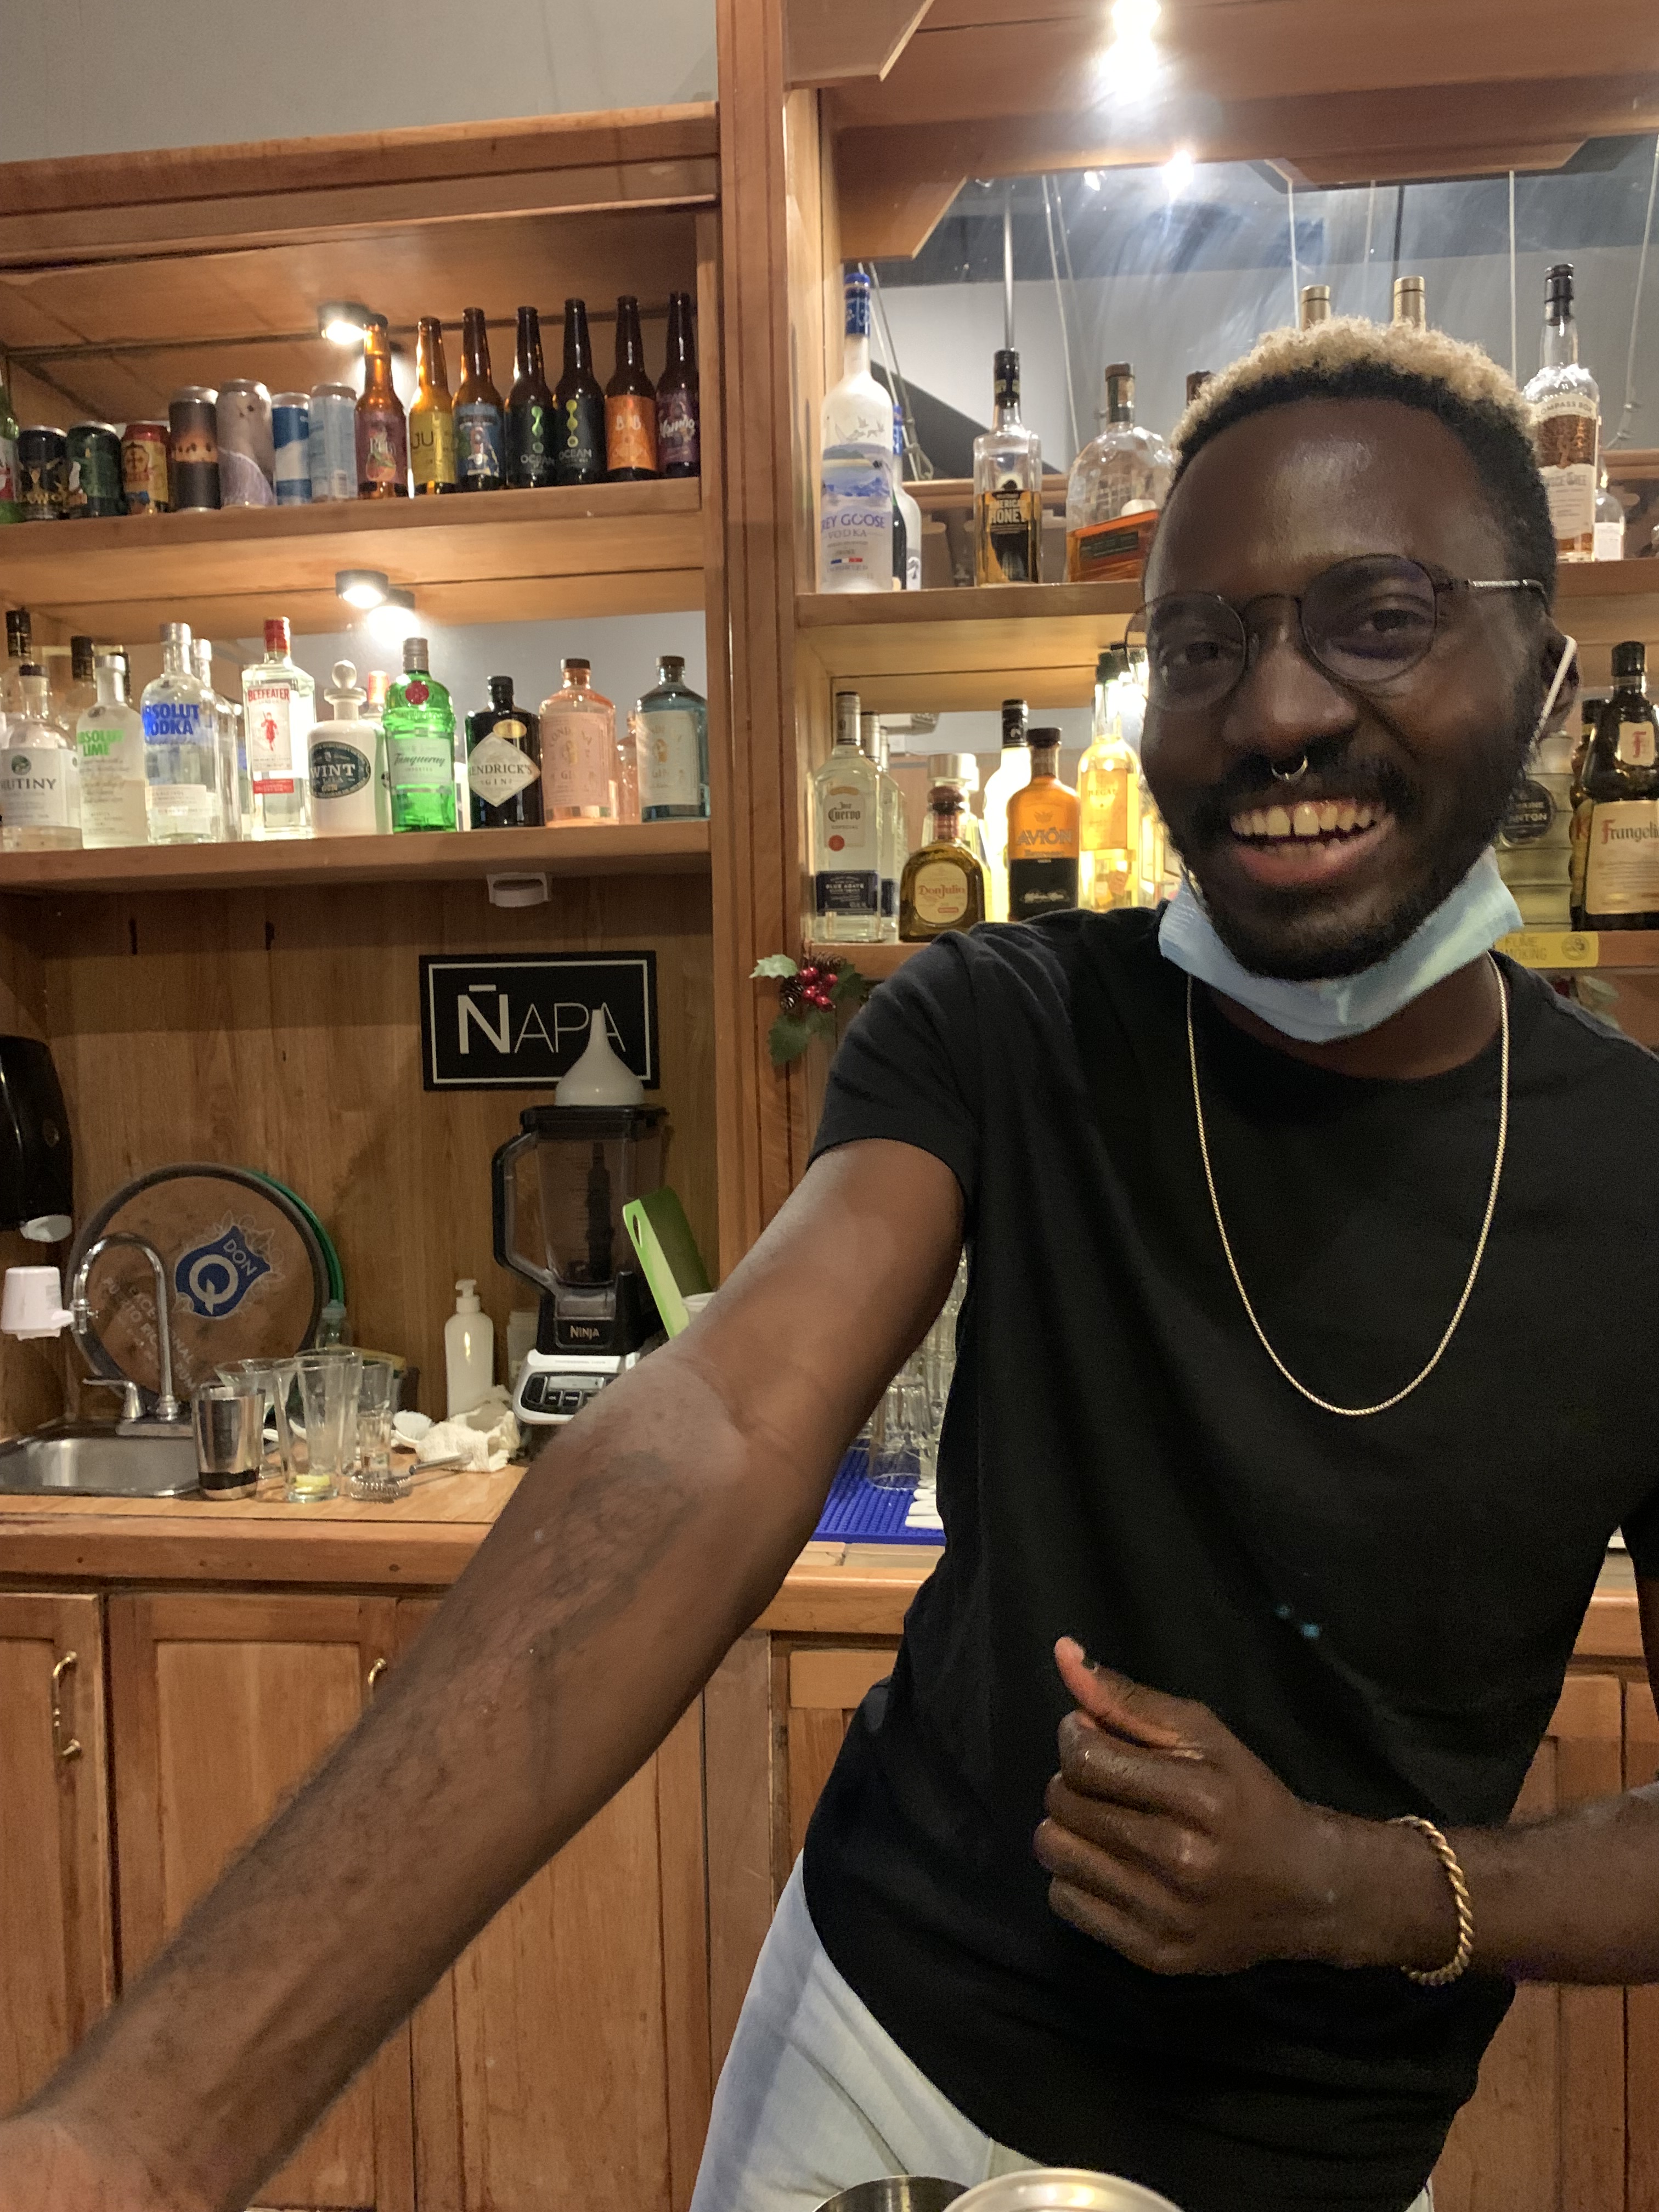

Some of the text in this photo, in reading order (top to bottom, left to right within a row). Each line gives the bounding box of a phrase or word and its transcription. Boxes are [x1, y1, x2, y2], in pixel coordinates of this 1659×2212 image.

[841, 513, 885, 528] GOOSE
[828, 528, 867, 539] VODKA
[248, 688, 290, 701] BEEFEATER
[394, 752, 445, 768] Tanqueray
[828, 807, 861, 822] Cuervo
[1017, 826, 1072, 845] AVIÓN
[223, 1239, 257, 1276] DON
[189, 1254, 239, 1314] Q
[570, 1325, 600, 1340] NINJA
